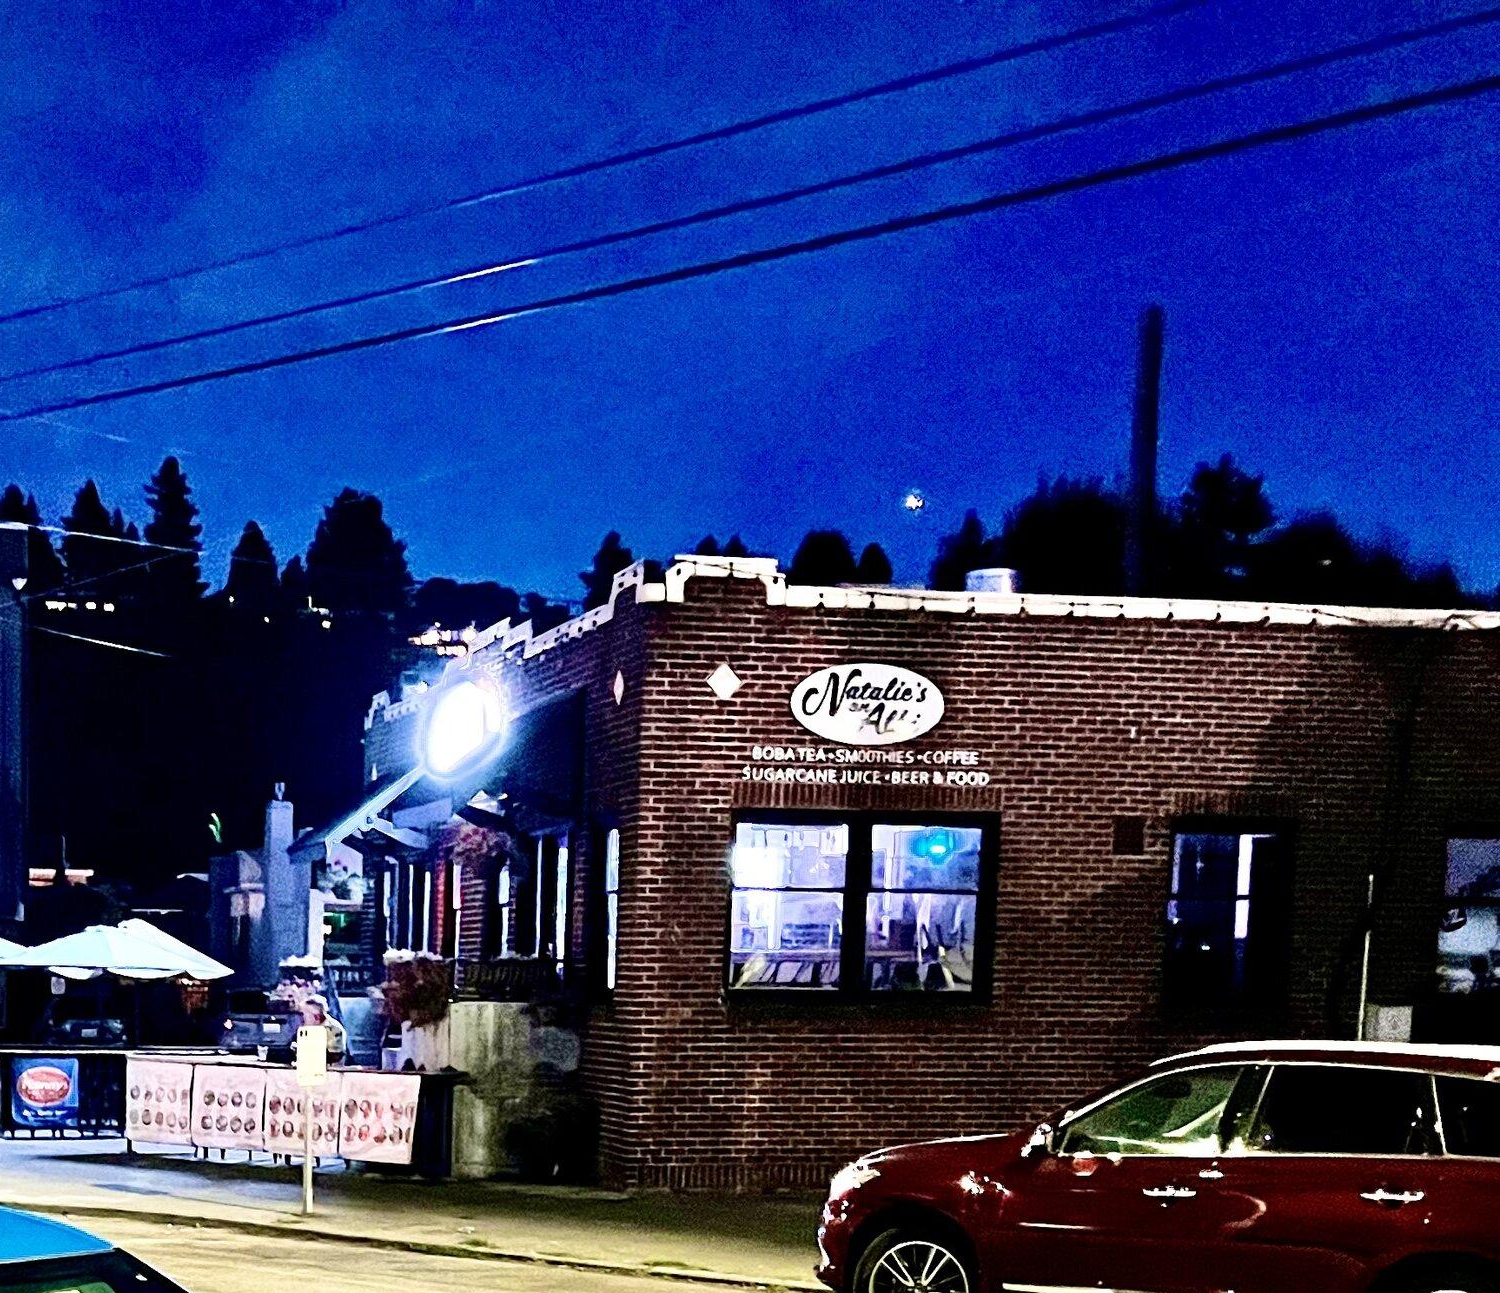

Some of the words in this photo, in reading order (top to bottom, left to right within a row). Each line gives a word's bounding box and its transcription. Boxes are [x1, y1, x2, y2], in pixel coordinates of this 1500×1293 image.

[802, 668, 928, 717] Natalie's
[751, 747, 799, 761] BOBA
[799, 749, 825, 762] TEA
[836, 749, 914, 764] SMOOTHIES
[924, 751, 979, 765] COFFEE
[741, 766, 837, 784] SUGARCANE
[840, 771, 881, 784] JUICE
[891, 771, 929, 784] BEER
[946, 771, 990, 785] FOOD
